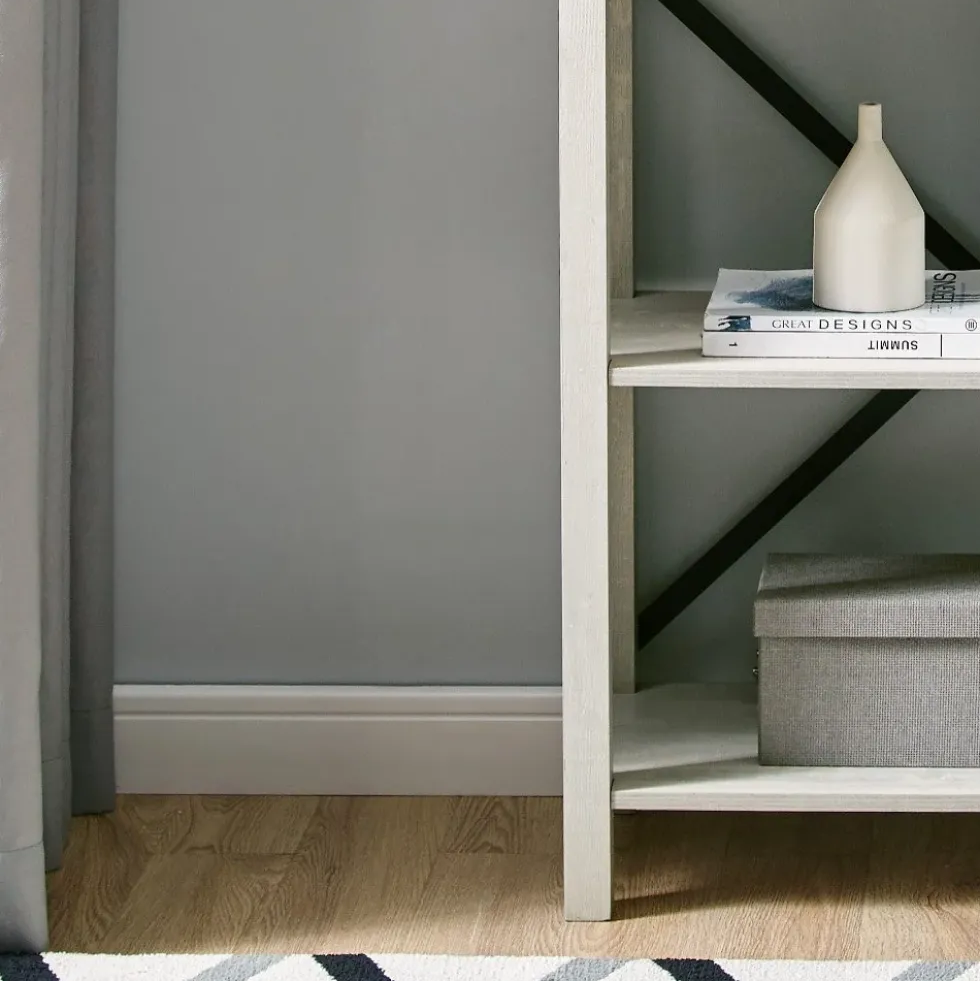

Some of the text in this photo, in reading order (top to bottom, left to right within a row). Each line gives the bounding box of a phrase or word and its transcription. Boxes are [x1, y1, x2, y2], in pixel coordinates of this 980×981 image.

[771, 319, 912, 330] GREAT DESIGNS
[867, 340, 918, 350] SUMMIT
